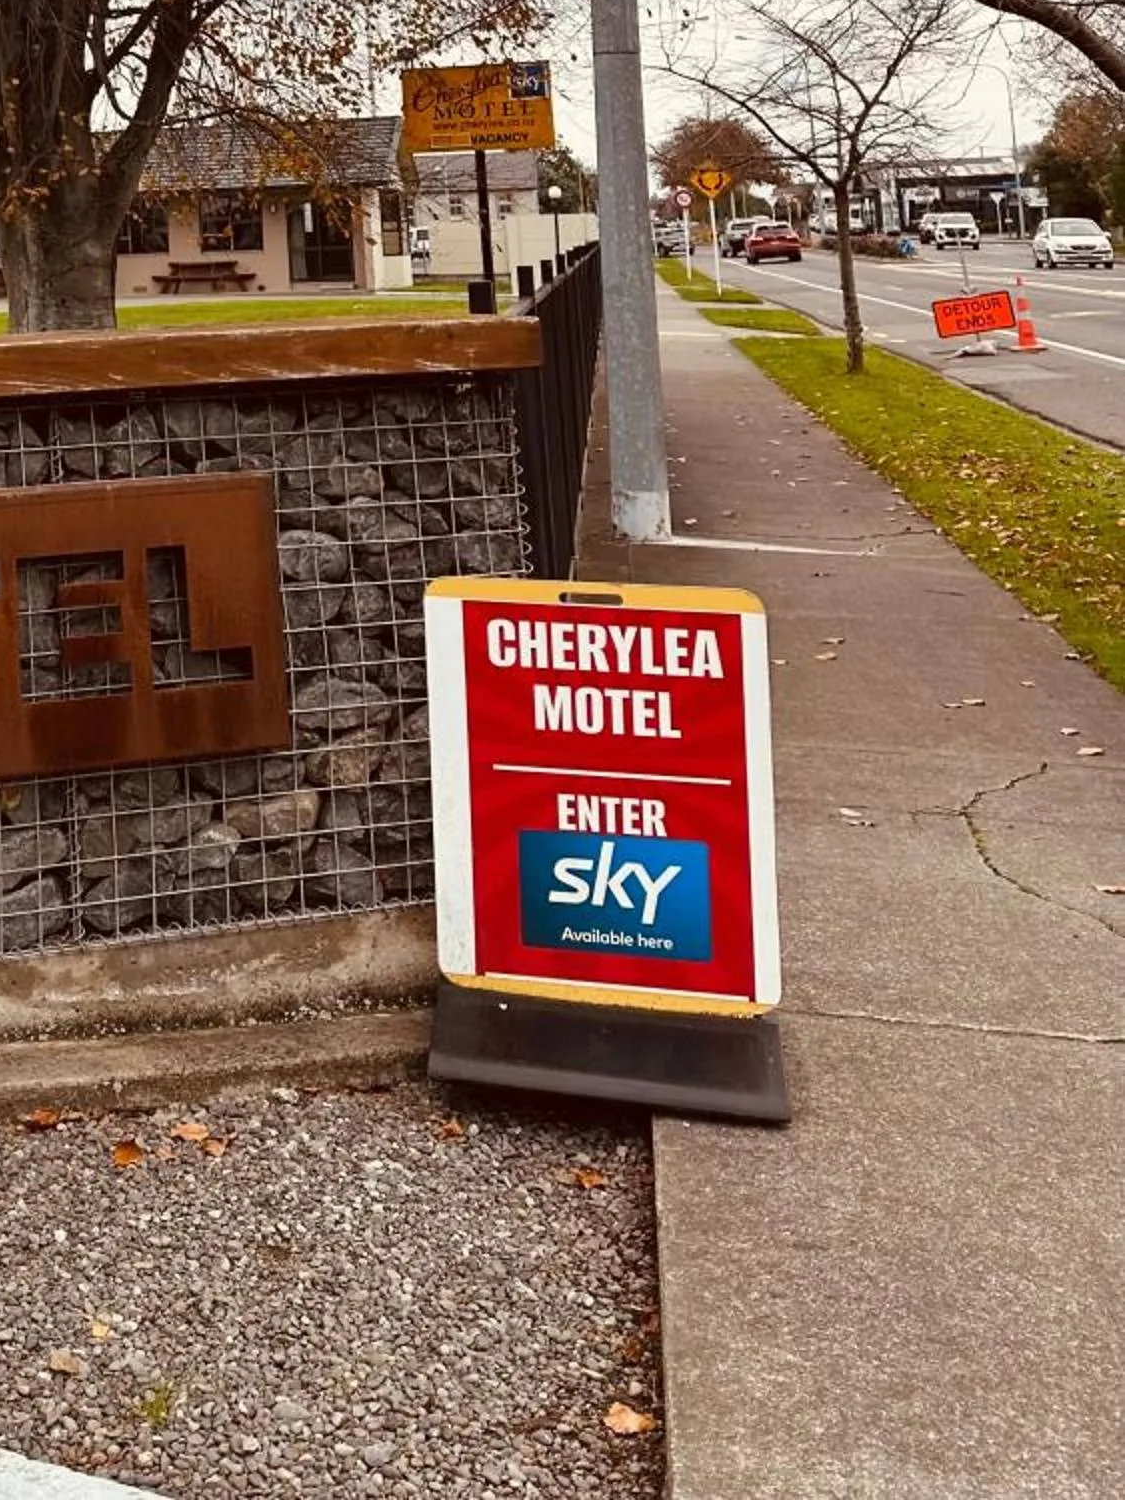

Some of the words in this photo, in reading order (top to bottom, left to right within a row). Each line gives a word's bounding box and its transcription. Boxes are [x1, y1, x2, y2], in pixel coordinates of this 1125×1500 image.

[433, 101, 536, 120] MOTEL
[470, 132, 530, 145] VACANCY
[942, 297, 1003, 318] DETOUR
[956, 314, 997, 331] ENDS
[486, 618, 724, 679] CHERYLEA
[532, 683, 682, 739] MOTEL
[557, 793, 667, 837] ENTER
[561, 926, 634, 947] Available
[637, 932, 674, 951] here
